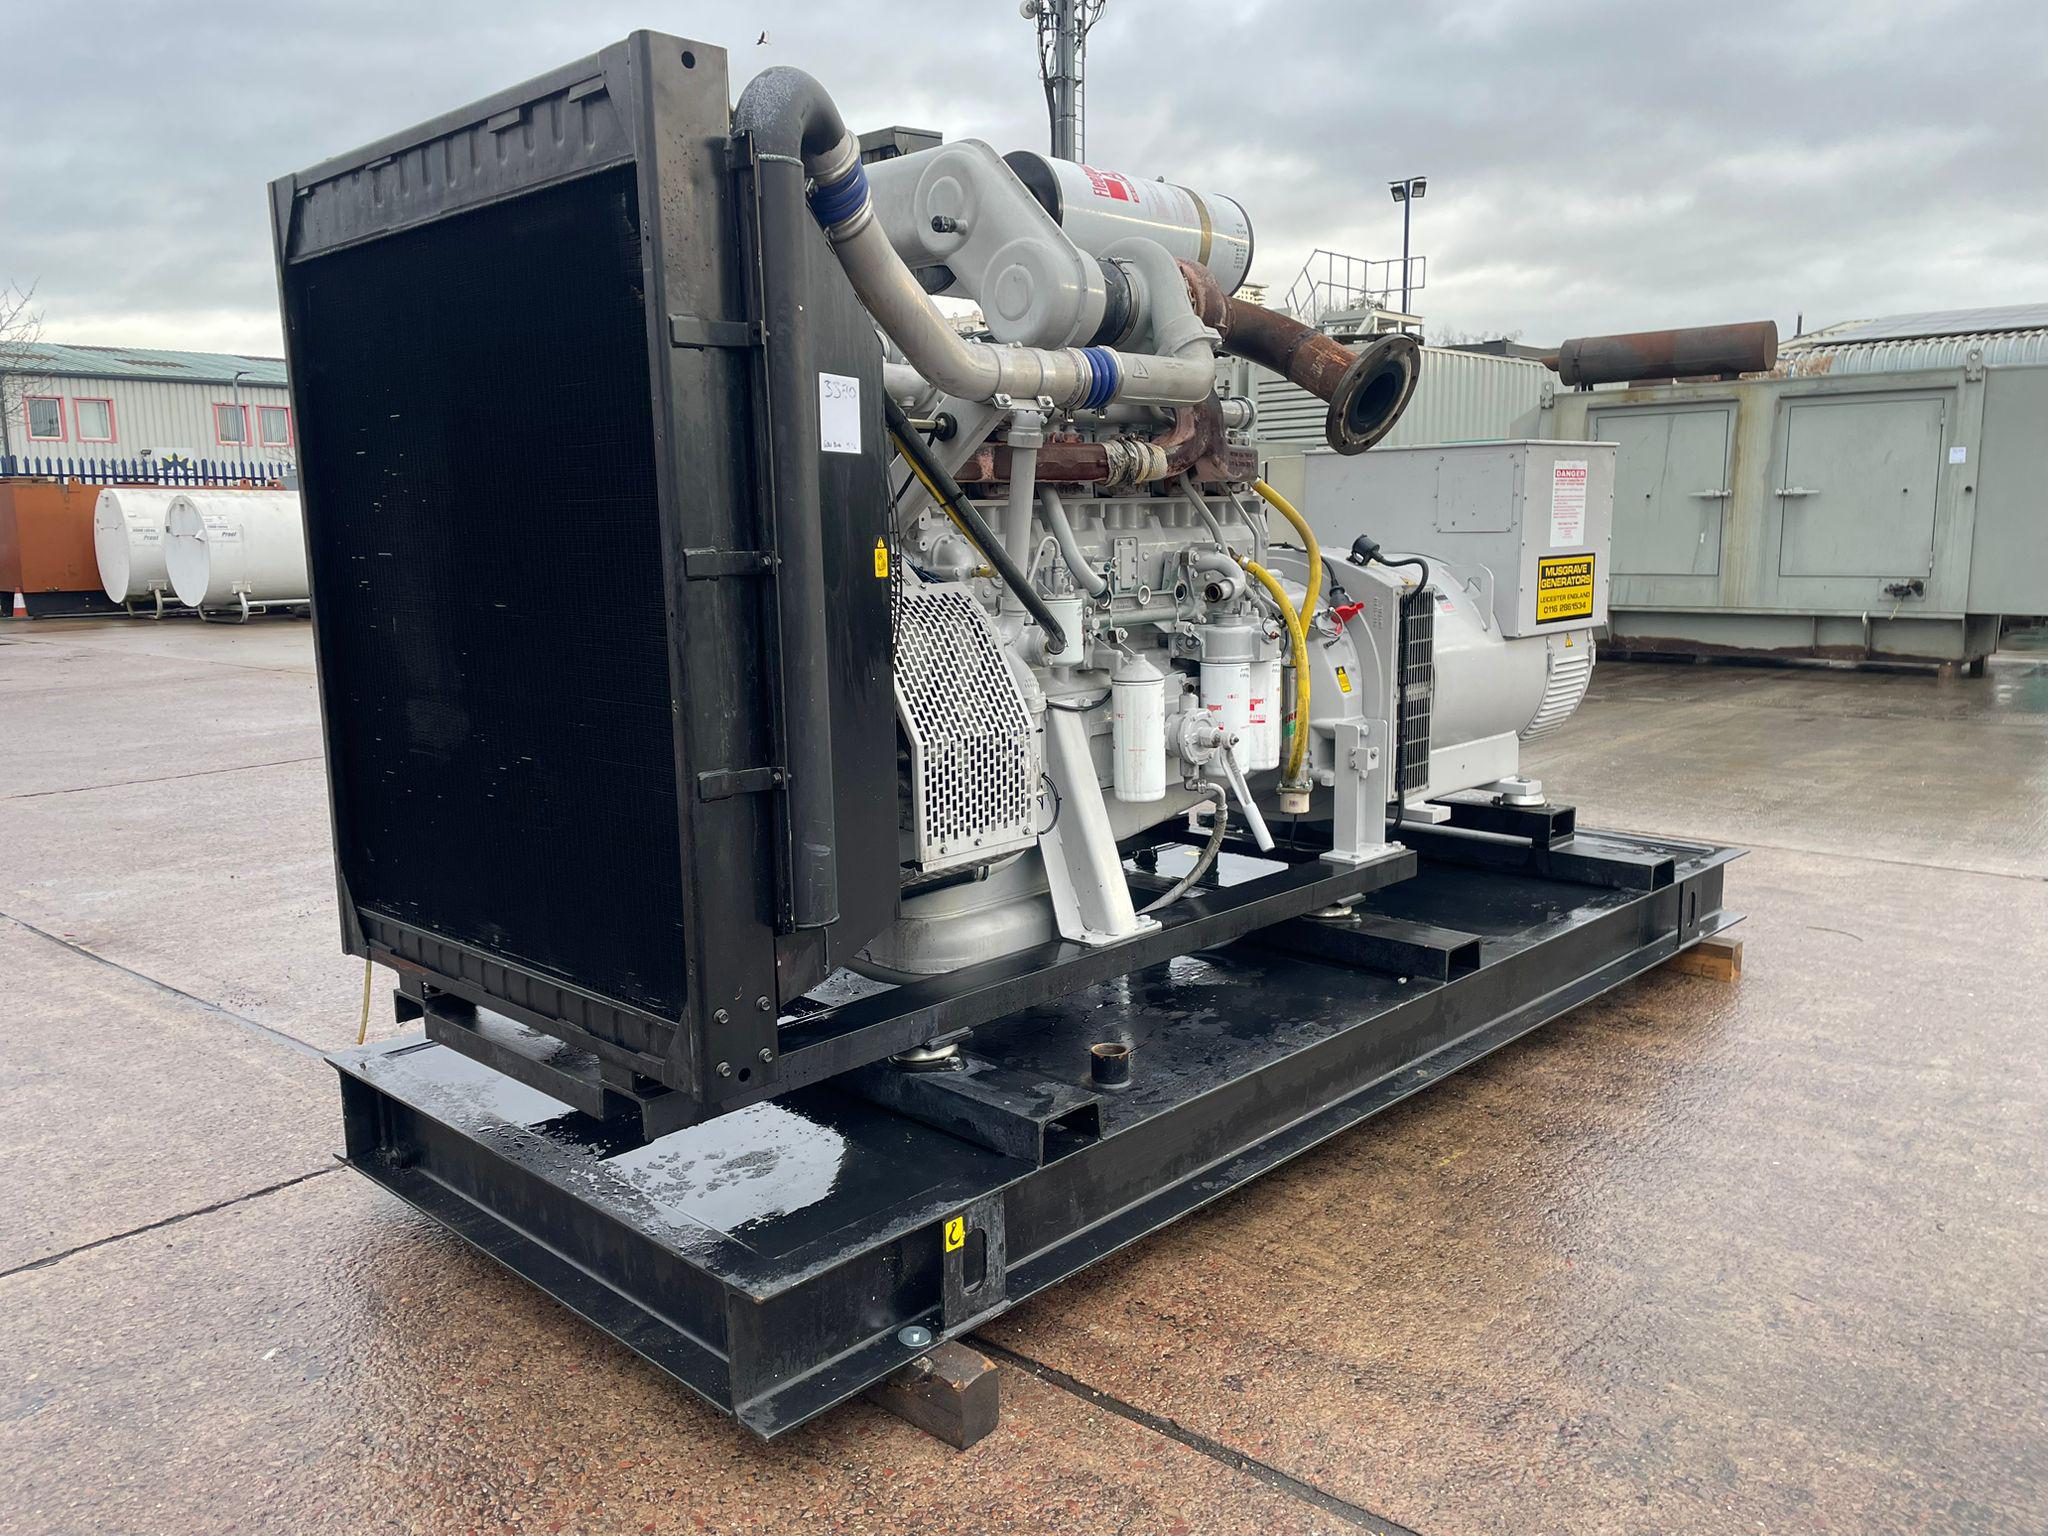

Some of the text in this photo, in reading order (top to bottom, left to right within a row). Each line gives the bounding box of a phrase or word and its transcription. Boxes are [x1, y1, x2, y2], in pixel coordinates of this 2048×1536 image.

[1556, 470, 1585, 478] DANGER
[1545, 564, 1588, 577] MUSGRAVE
[1541, 575, 1591, 589] GENERATORS
[1540, 592, 1591, 603] LEICESTER ENGLAND
[1543, 605, 1558, 614] 0116
